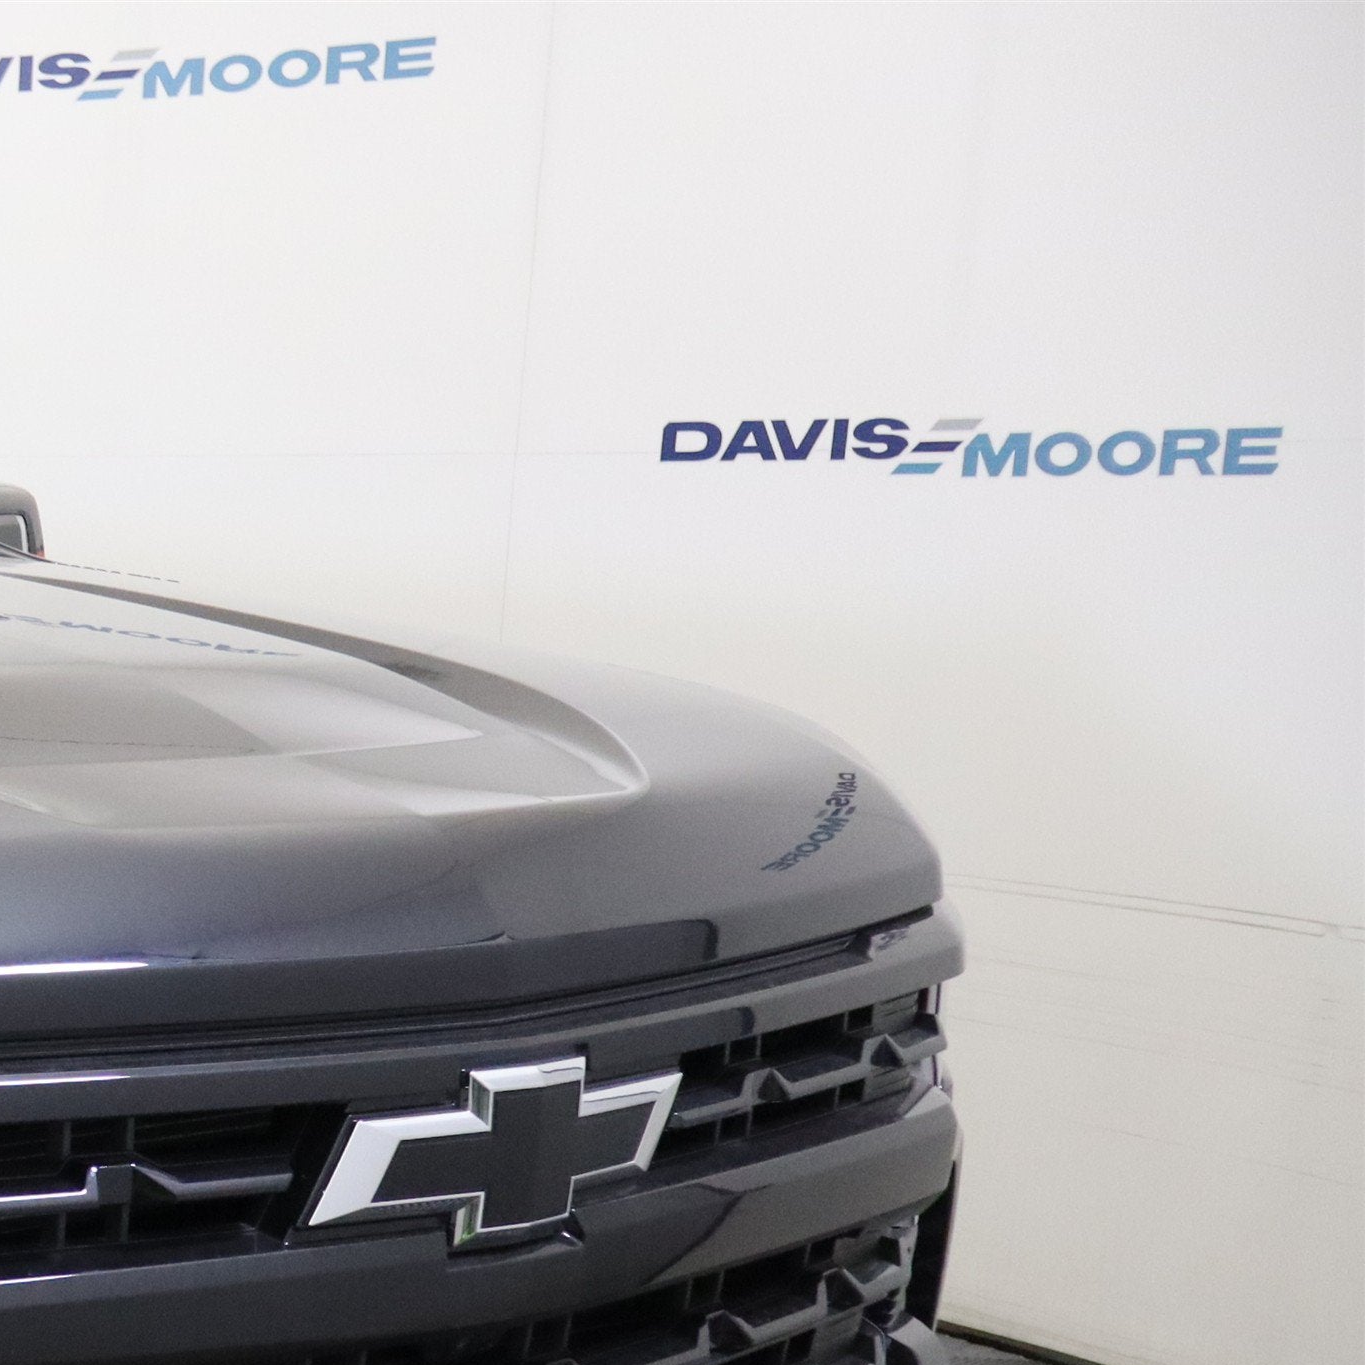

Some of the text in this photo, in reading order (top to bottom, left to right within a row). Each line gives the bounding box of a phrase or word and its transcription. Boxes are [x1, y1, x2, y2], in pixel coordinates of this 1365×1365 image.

[141, 35, 438, 99] MOORE
[659, 417, 1285, 478] DAVIS MOORE
